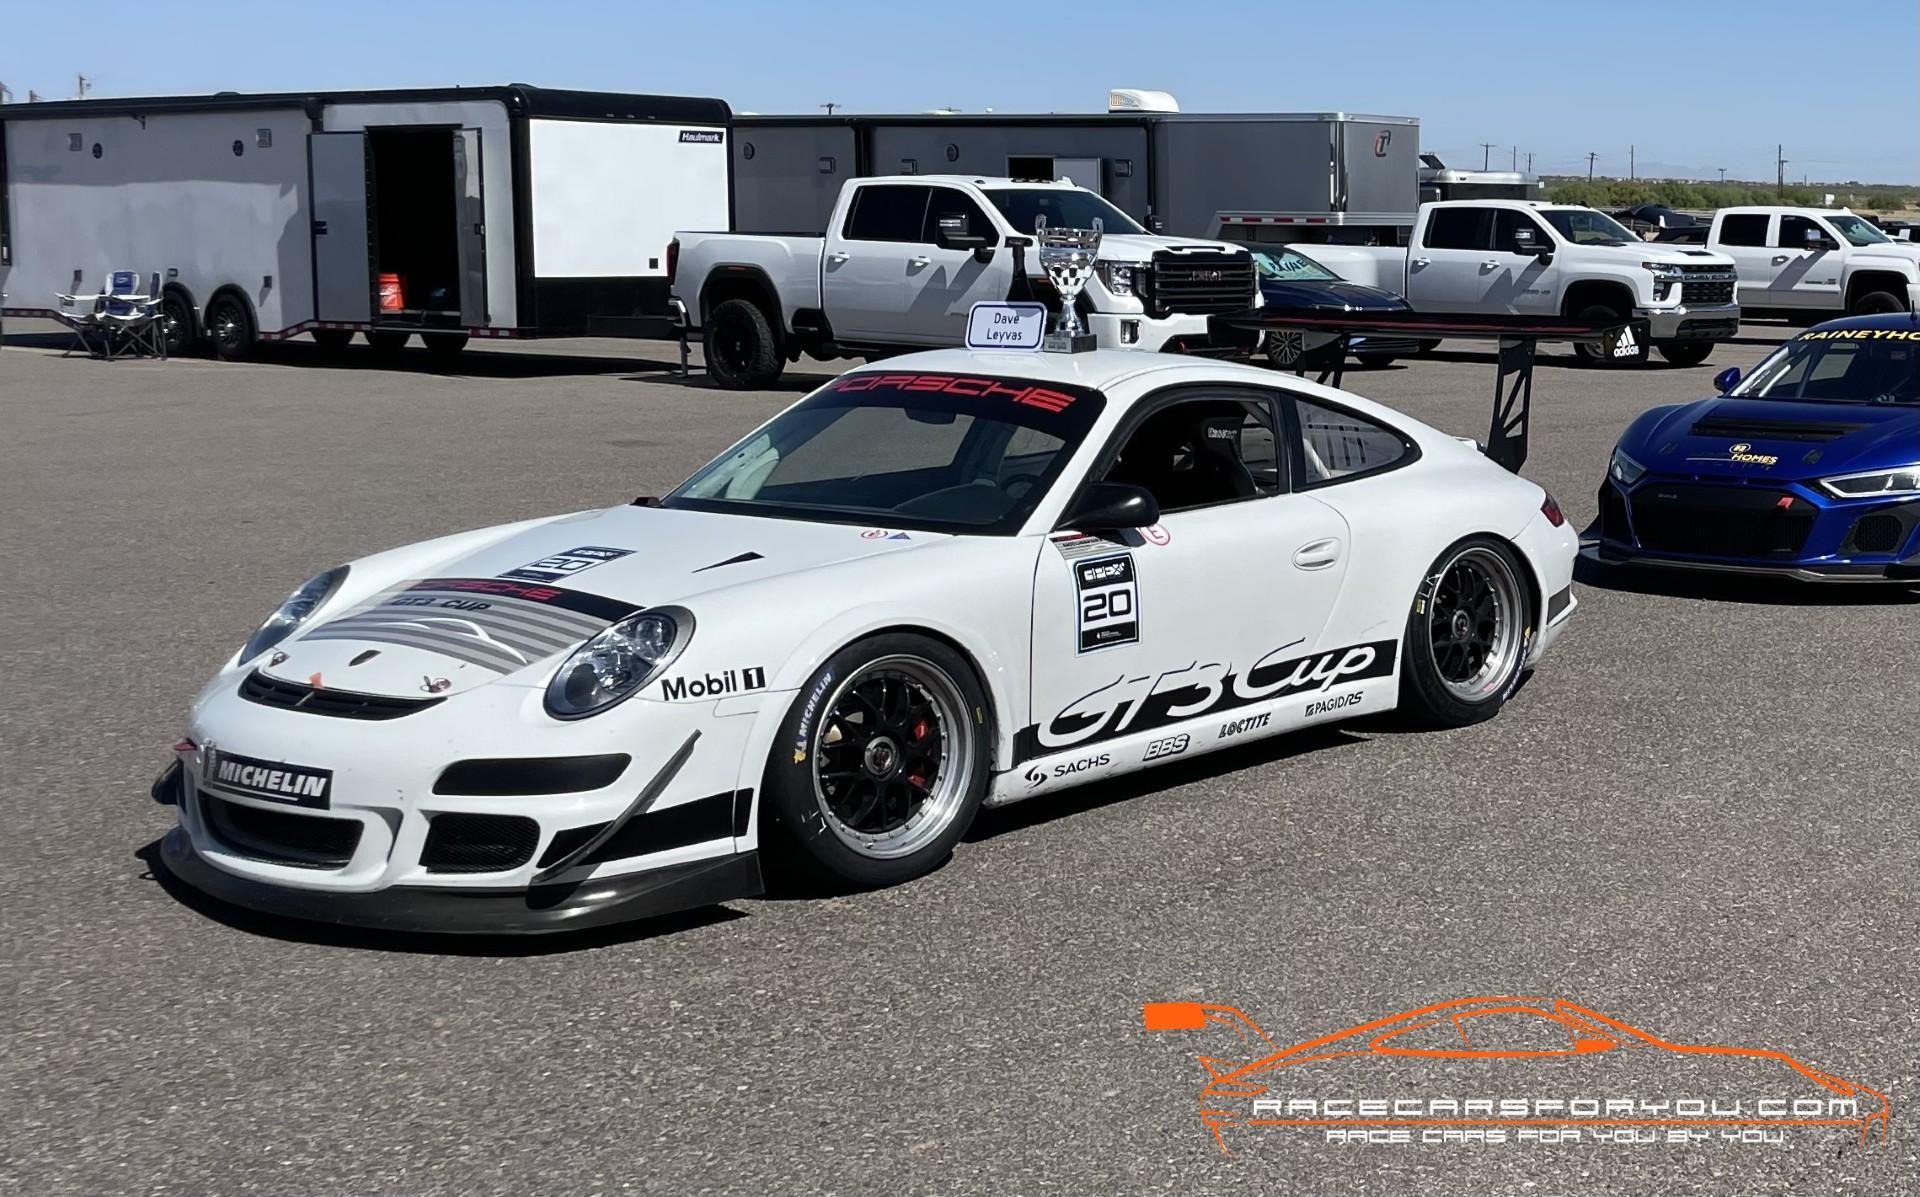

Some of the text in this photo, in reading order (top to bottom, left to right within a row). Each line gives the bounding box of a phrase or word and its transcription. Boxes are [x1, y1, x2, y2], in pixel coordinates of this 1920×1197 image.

[682, 132, 720, 142] Haulmark
[994, 312, 1020, 325] Dave
[986, 328, 1022, 342] Leyvas
[1614, 344, 1639, 358] adidas
[1731, 453, 1778, 465] HOMES
[408, 579, 562, 600] SCHE
[442, 600, 492, 611] CUP
[1083, 589, 1132, 623] 20
[661, 670, 737, 701] Mobil
[1038, 637, 1375, 747] GT3 Cup
[798, 672, 833, 738] MICHELIN
[1218, 712, 1272, 739] LOCTITE
[1143, 734, 1190, 762] BBS
[1054, 754, 1111, 778] SACHS
[218, 760, 327, 797] MICHELIN
